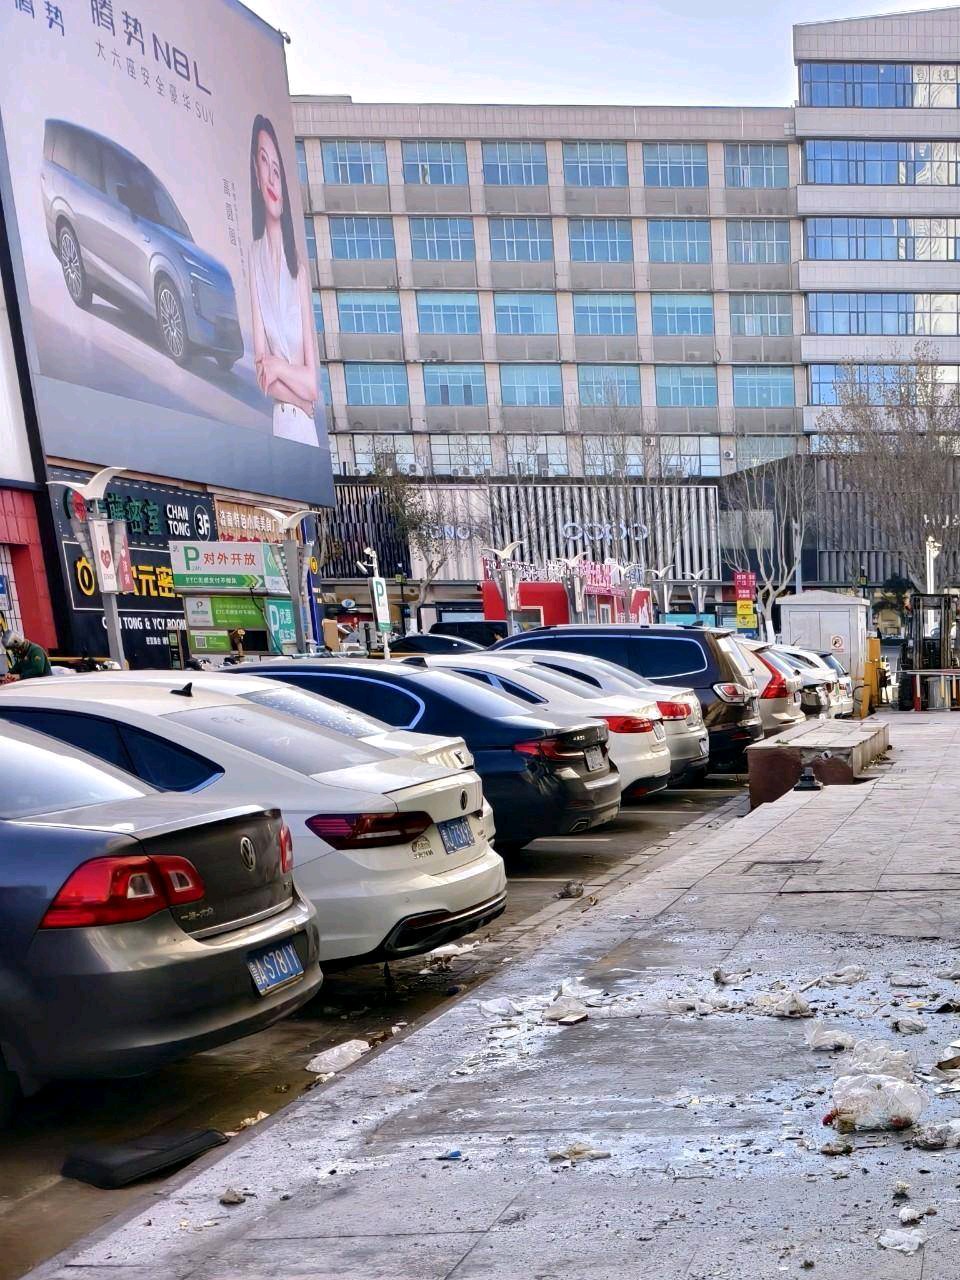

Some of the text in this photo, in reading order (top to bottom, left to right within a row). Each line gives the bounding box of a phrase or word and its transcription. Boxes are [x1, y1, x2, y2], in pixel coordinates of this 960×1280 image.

[166, 504, 189, 521] CHAN
[168, 520, 191, 536] TONG
[197, 514, 210, 535] 3F
[184, 546, 199, 570] P
[203, 552, 256, 566] 对外开放
[122, 617, 143, 630] TONG
[152, 618, 165, 630] YCY
